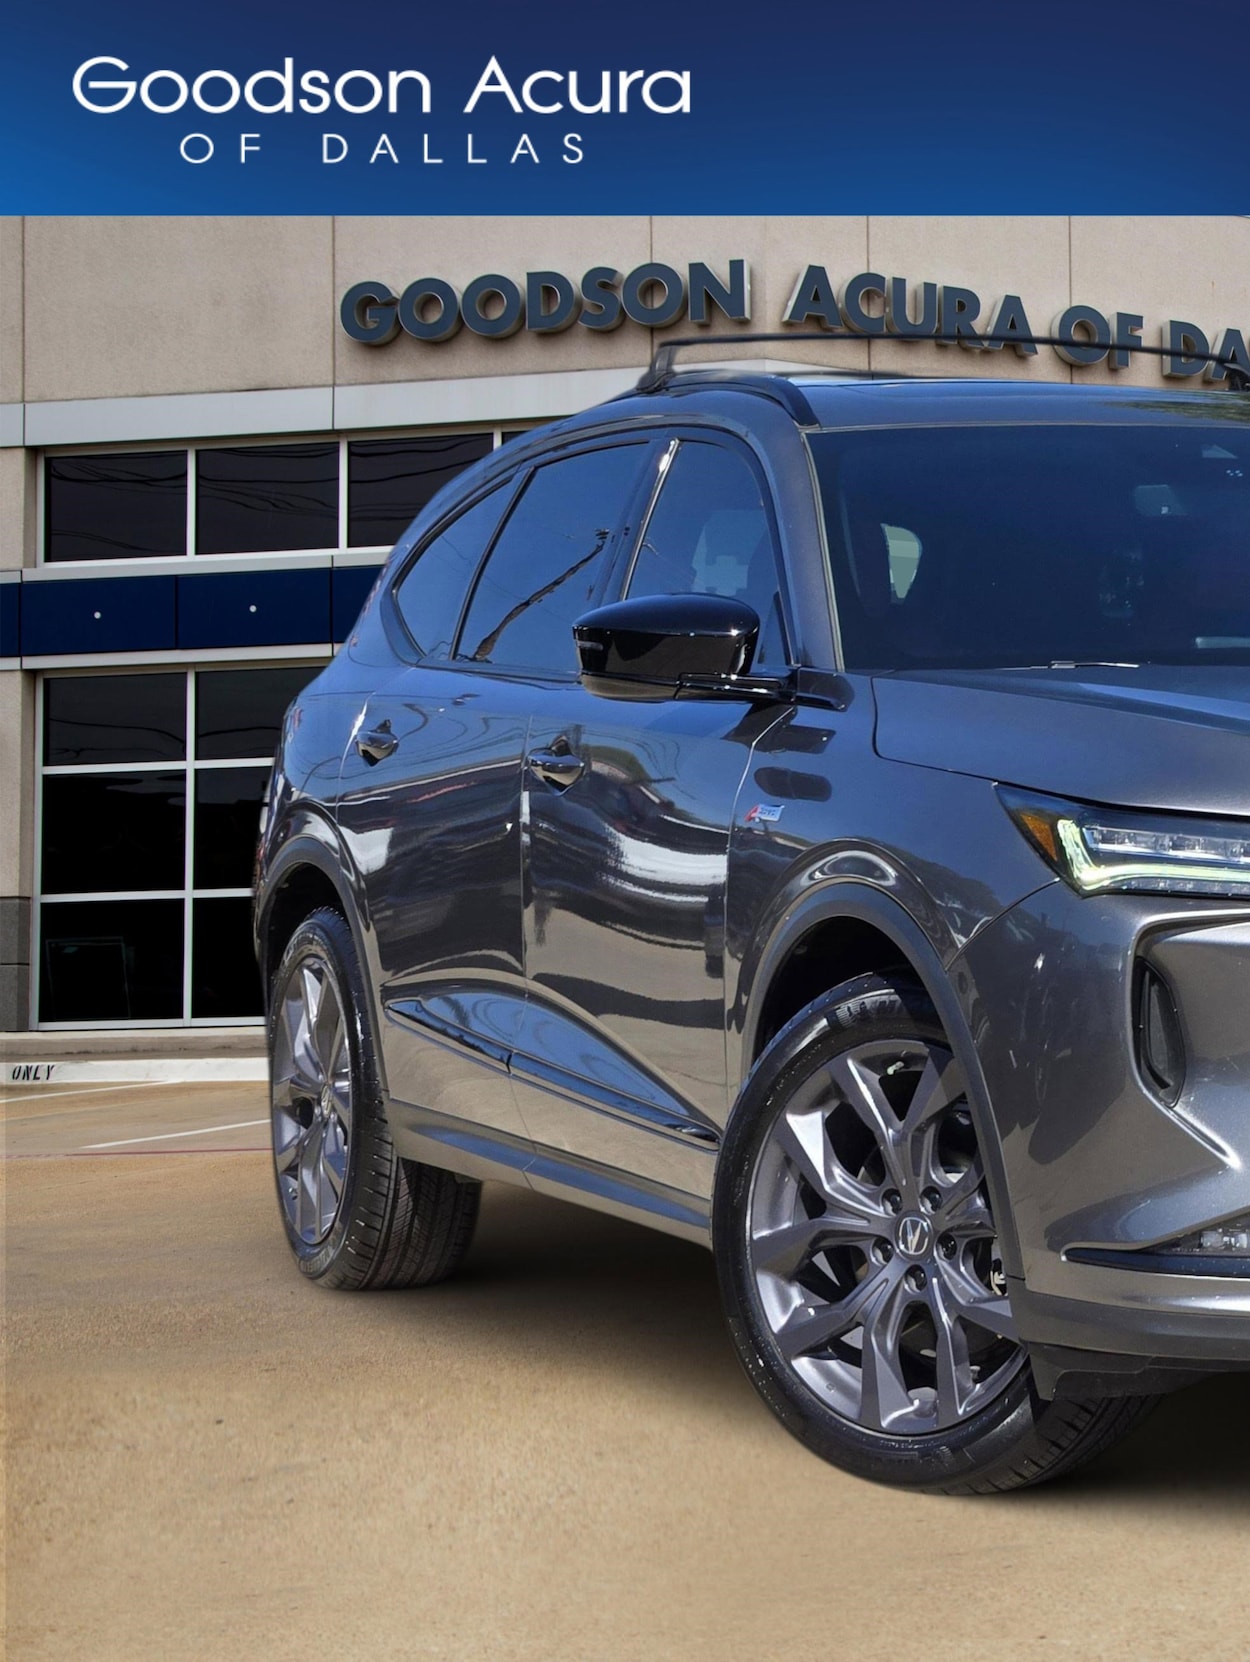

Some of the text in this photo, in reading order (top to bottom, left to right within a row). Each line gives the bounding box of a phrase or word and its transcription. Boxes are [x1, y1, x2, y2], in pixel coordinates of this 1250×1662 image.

[340, 259, 750, 345] GOODSON
[782, 264, 1038, 357] ACURA
[1051, 304, 1144, 369] OF
[12, 1064, 55, 1080] ONLY
